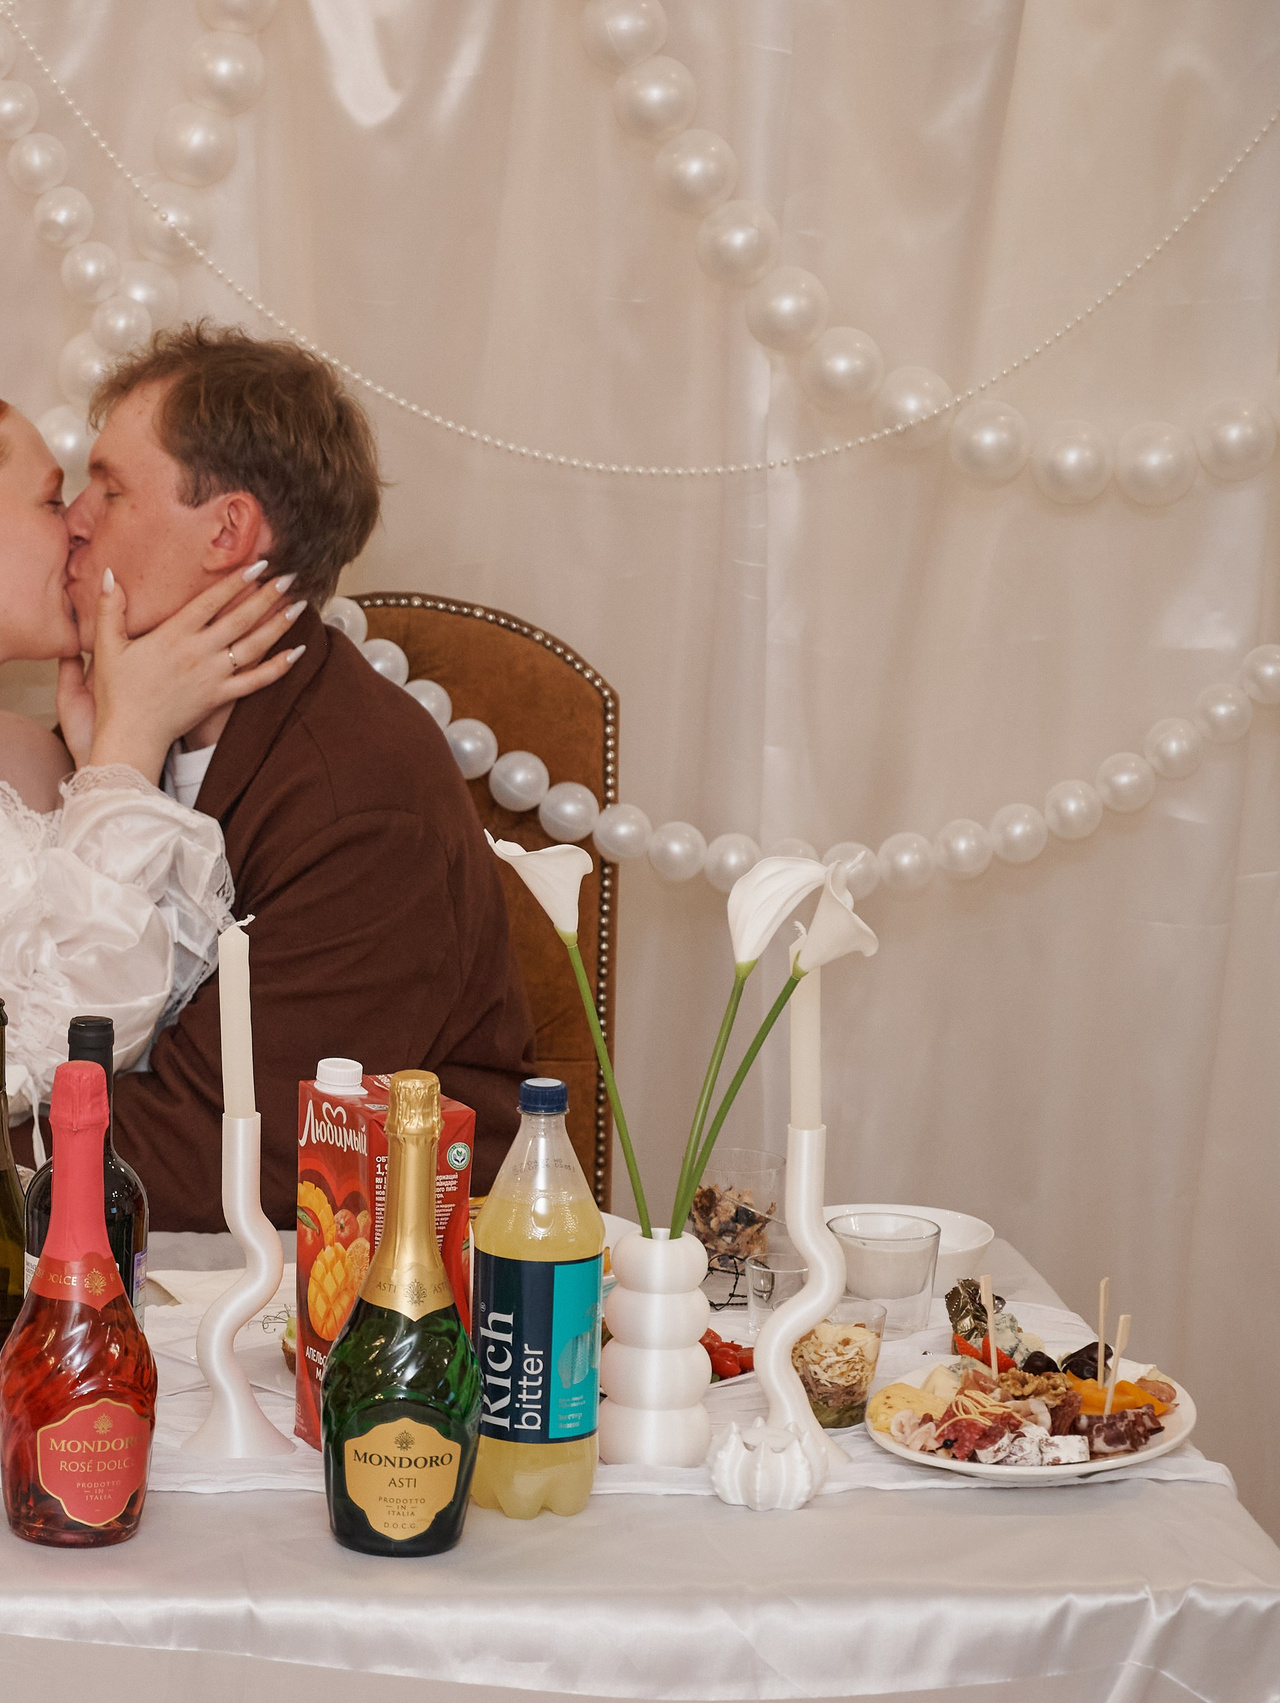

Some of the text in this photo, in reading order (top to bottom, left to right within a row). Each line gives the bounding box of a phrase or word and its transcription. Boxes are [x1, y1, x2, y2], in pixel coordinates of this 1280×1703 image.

[299, 1099, 368, 1157] Любимый
[376, 1281, 397, 1294] ASTI
[479, 1311, 514, 1432] Rich
[514, 1343, 544, 1431] bitter
[49, 1436, 139, 1454] MONDOR
[59, 1457, 134, 1473] ROSÉ DOLC
[353, 1449, 453, 1470] MONDORO
[76, 1480, 122, 1489] PRODOTTO
[388, 1477, 417, 1488] ASTI
[378, 1496, 426, 1505] PRODOTTO
